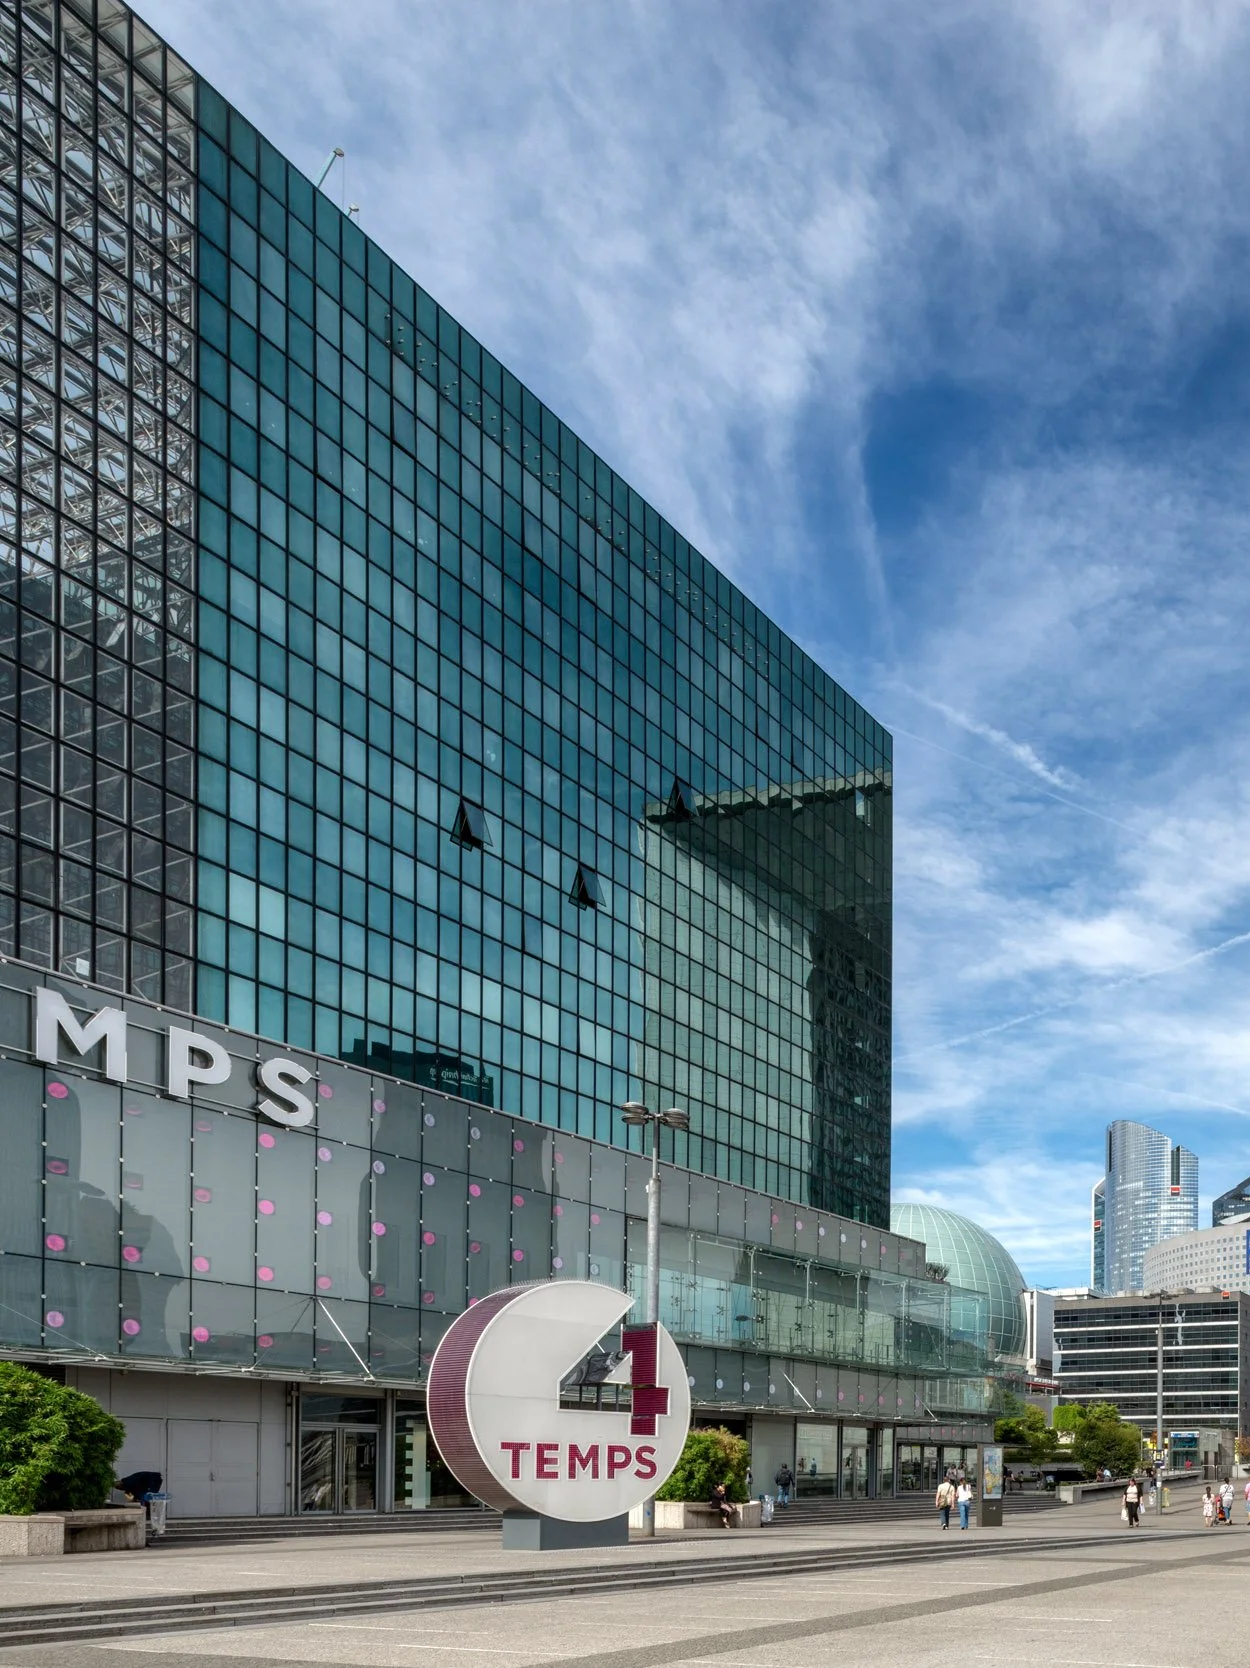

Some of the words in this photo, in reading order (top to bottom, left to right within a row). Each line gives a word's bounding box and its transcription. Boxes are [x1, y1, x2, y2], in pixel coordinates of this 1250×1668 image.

[35, 986, 314, 1127] MPS
[557, 1318, 671, 1437] 4
[500, 1441, 658, 1481] TEMPS
